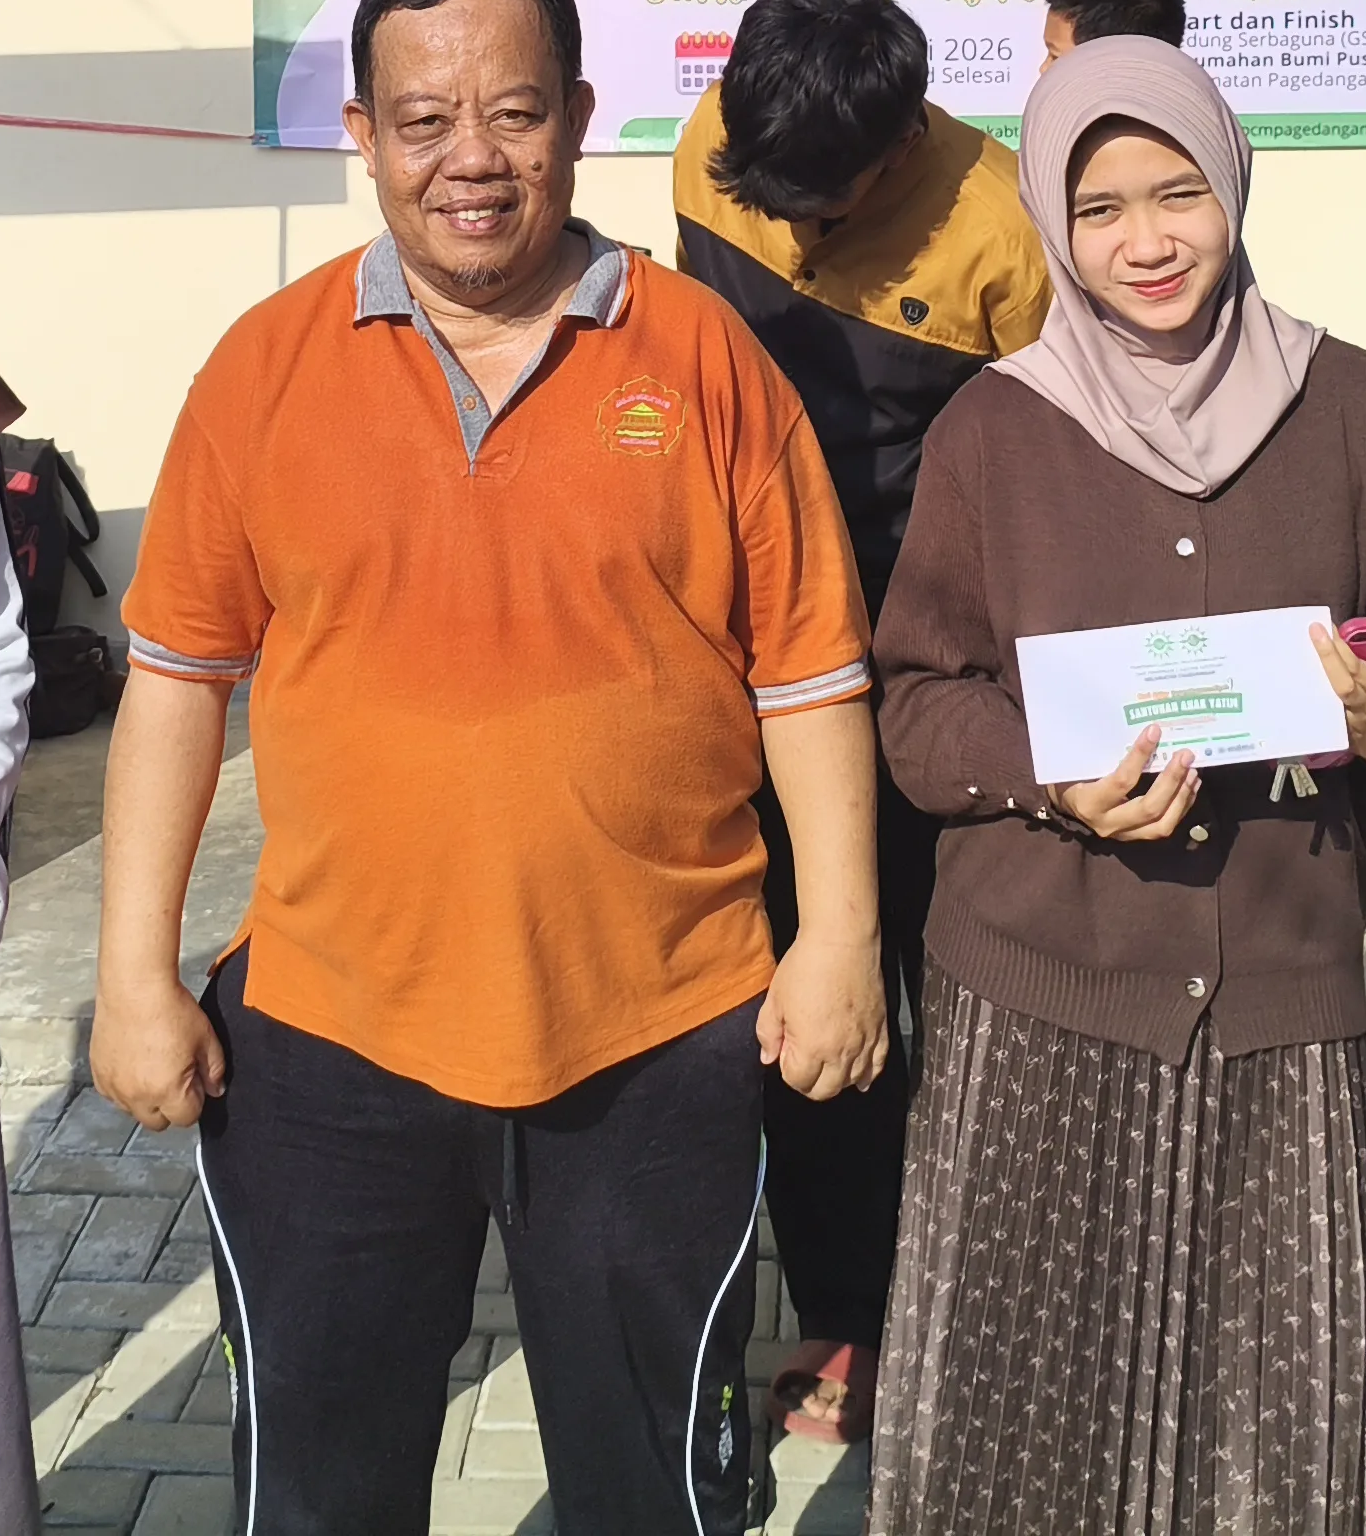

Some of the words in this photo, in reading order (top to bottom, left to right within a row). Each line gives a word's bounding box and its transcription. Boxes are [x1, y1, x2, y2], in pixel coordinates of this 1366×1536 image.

[1187, 14, 1223, 30] art
[1230, 11, 1275, 30] dan
[1284, 10, 1355, 29] Finish
[944, 37, 1013, 61] 2026
[1238, 31, 1335, 51] Serbaguna
[1281, 52, 1330, 67] Bumi
[942, 66, 1011, 84] Selesai
